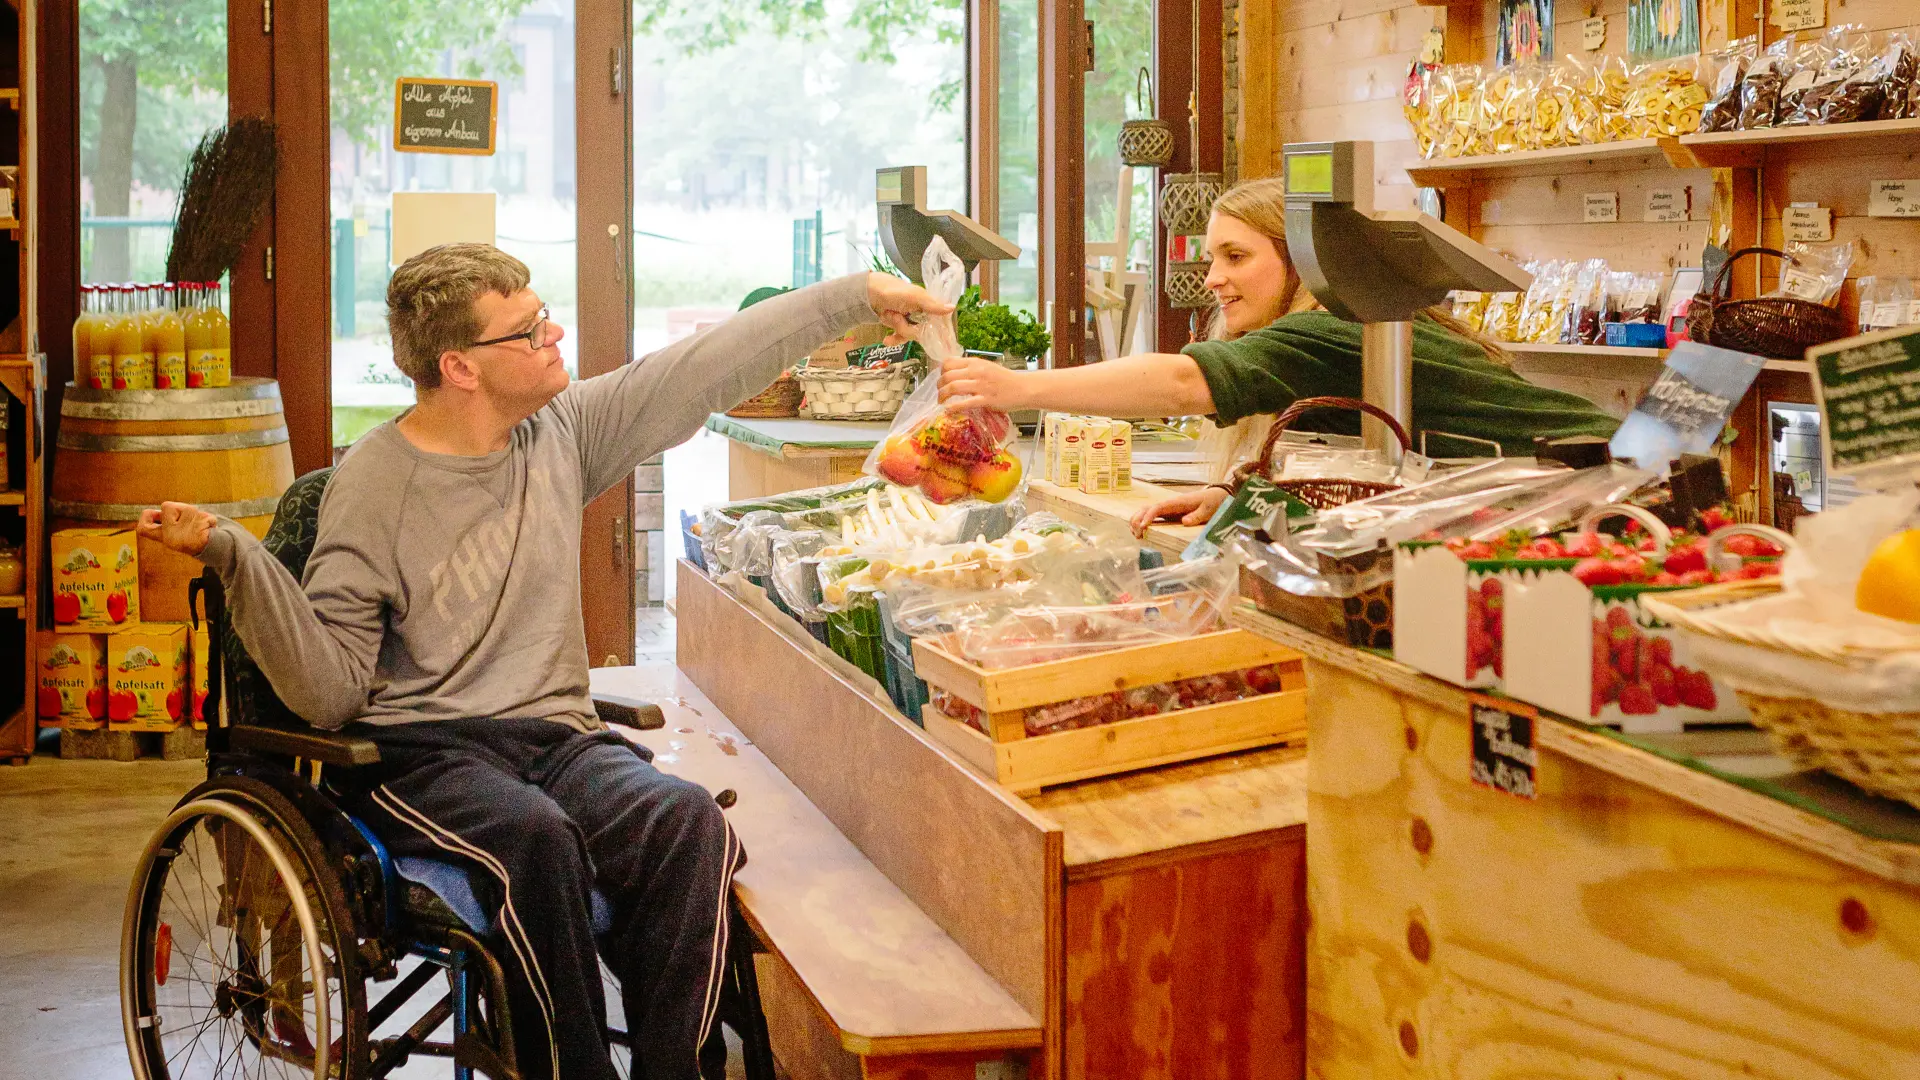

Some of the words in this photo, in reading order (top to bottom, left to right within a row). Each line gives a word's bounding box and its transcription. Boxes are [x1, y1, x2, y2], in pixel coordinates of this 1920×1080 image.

[404, 84, 432, 103] Alle
[438, 85, 474, 110] Äpfel
[425, 107, 445, 118] aus
[405, 124, 442, 143] eigenen
[444, 119, 480, 141] Anbau
[60, 582, 105, 593] Apfelsaft
[42, 677, 84, 689] Apfelsaft
[115, 680, 165, 691] Apfelsaft
